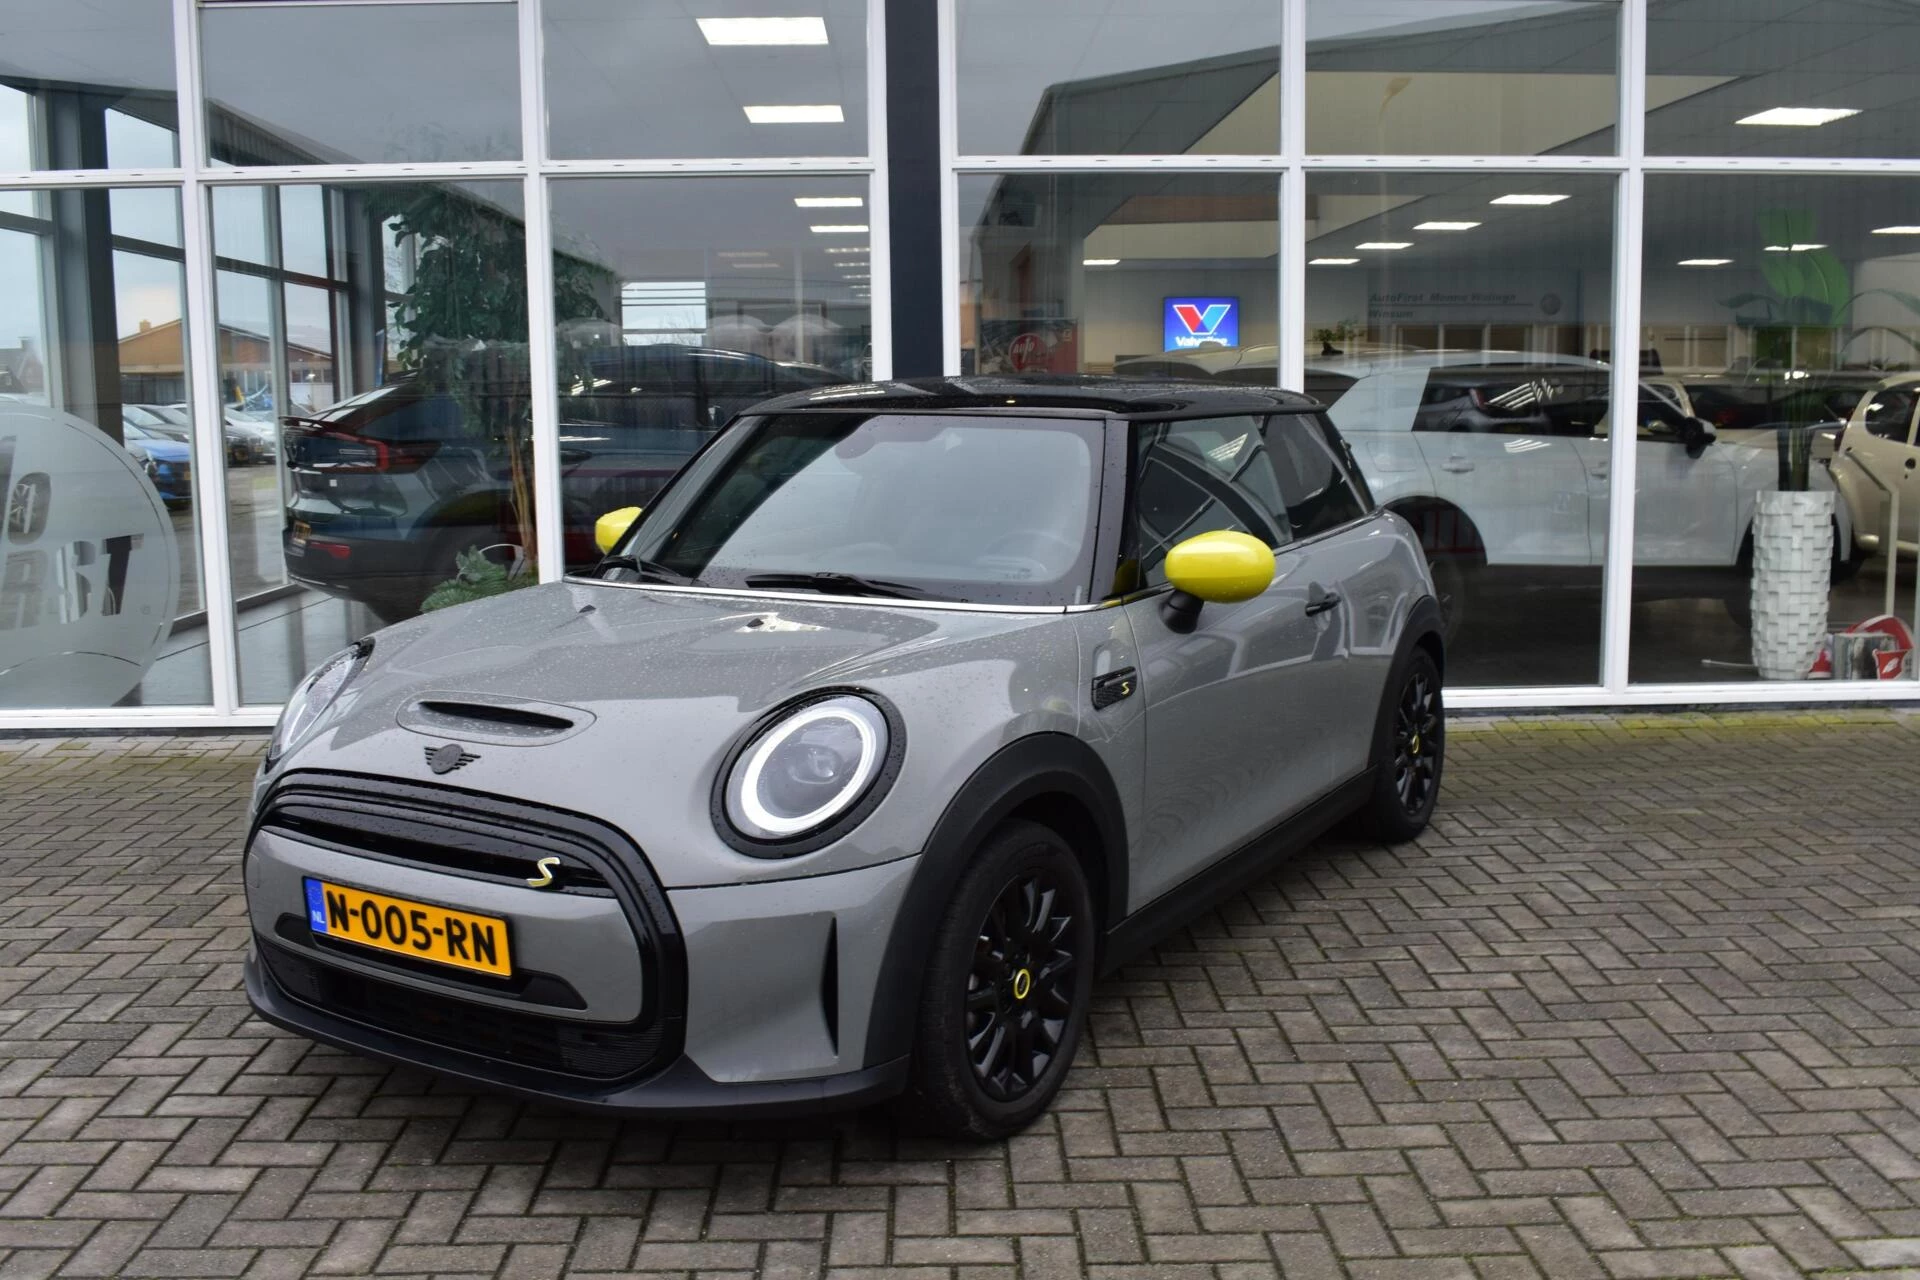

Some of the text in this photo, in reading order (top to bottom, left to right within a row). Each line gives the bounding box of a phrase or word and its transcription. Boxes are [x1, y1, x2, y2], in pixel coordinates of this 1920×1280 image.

[1175, 336, 1228, 347] Valve
[1121, 681, 1130, 695] S
[526, 856, 561, 887] S
[312, 910, 326, 924] NL
[326, 890, 498, 966] N-005-RN
